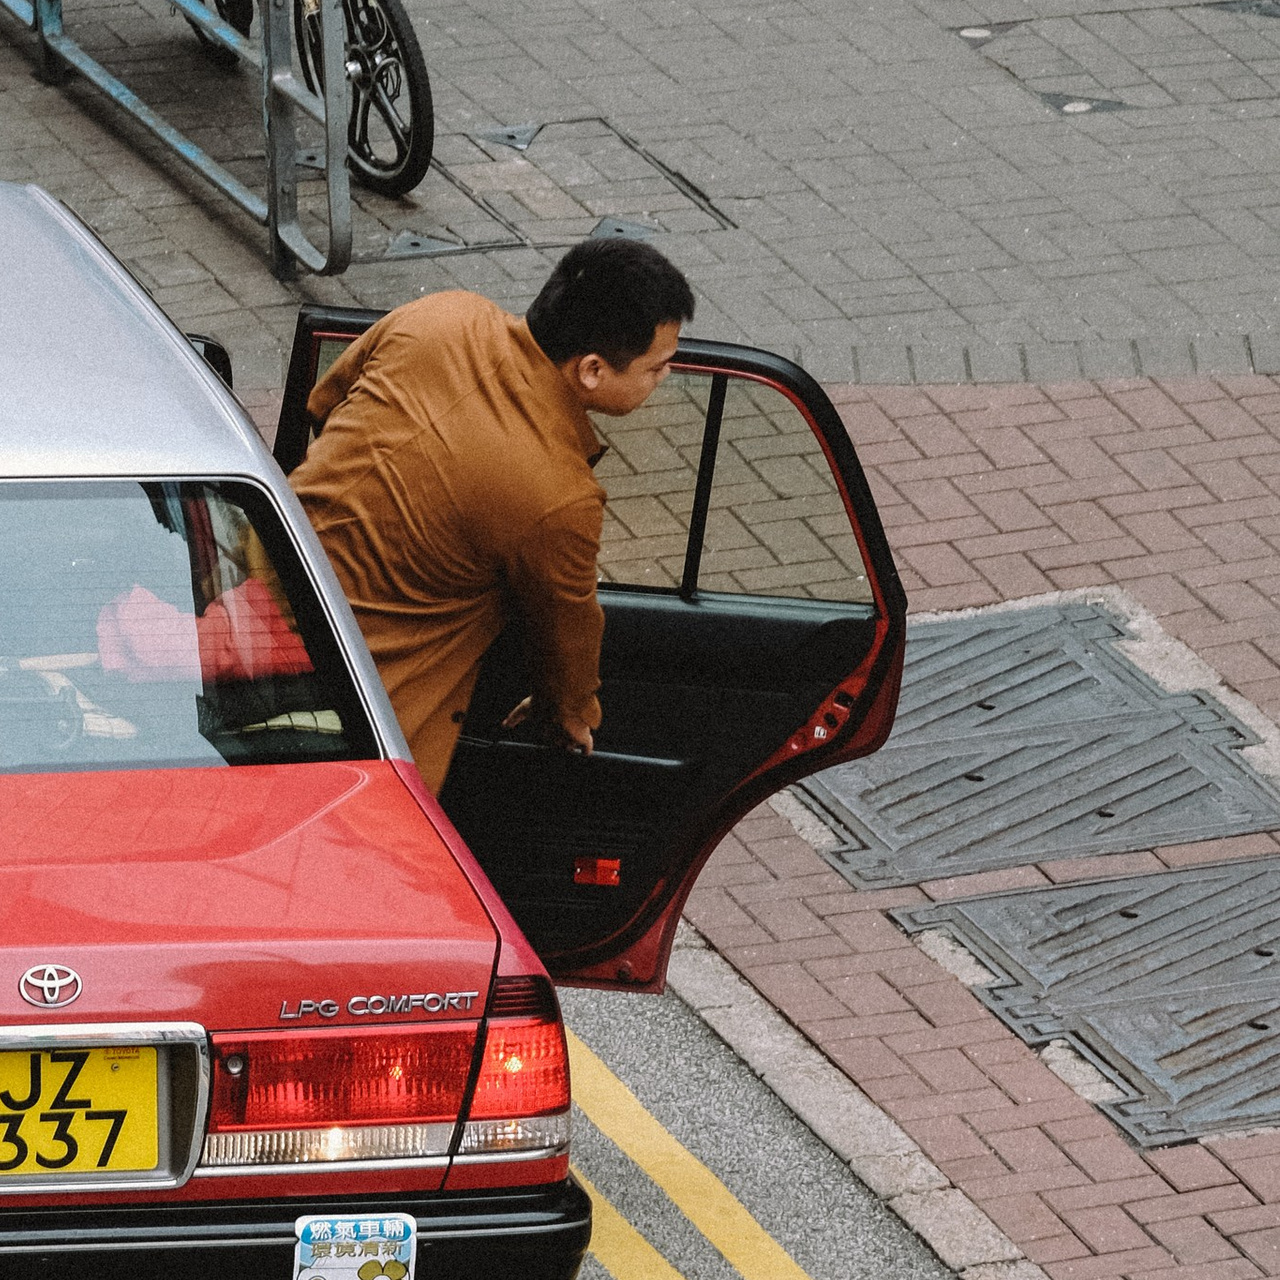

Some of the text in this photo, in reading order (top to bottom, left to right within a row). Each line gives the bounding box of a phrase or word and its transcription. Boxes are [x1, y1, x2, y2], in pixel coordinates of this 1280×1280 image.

[280, 991, 479, 1019] LPG COMFORT
[309, 1220, 405, 1239] 燃氣車輛
